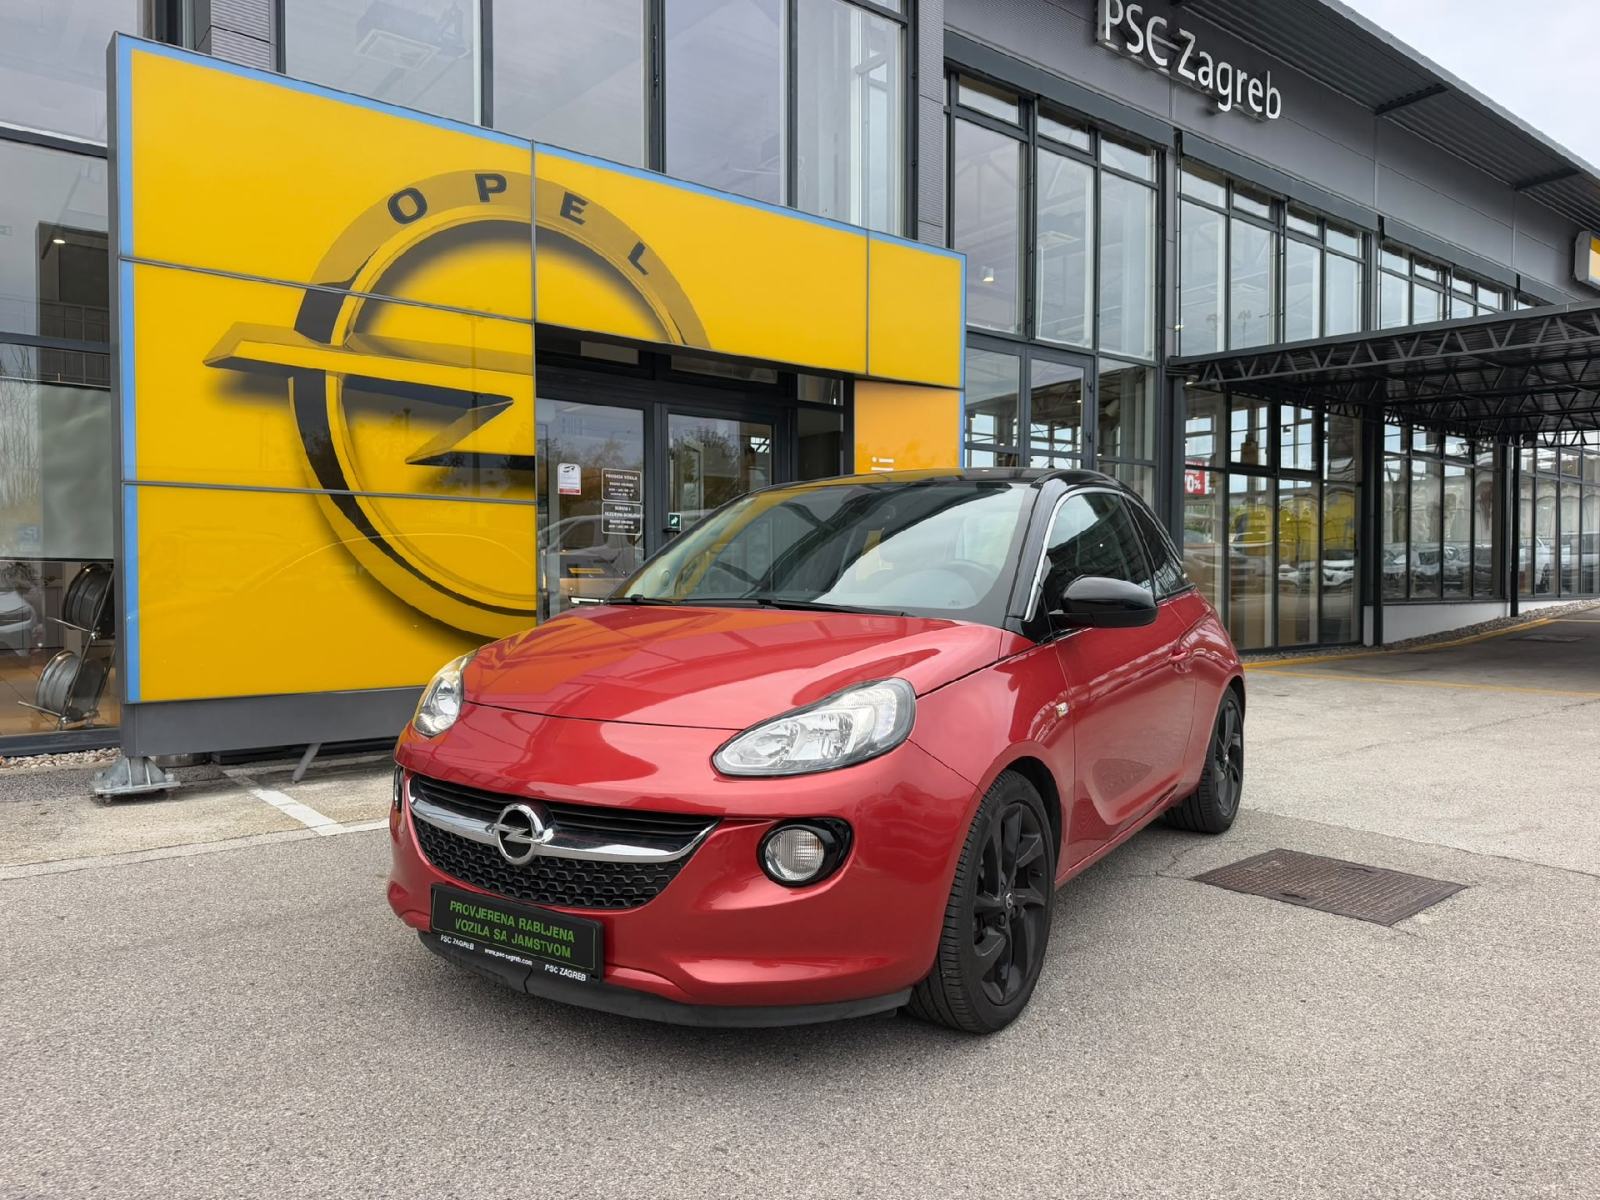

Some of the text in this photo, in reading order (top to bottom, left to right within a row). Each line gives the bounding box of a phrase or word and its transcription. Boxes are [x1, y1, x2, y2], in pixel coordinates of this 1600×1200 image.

[1105, 0, 1281, 119] PSC Zagreb
[387, 173, 648, 276] OPEL
[449, 900, 575, 944] PROVJERENA RABLJENA
[455, 918, 571, 958] VOZILA SA JAMSTVOM
[544, 963, 587, 982] PSC ZAGREB
